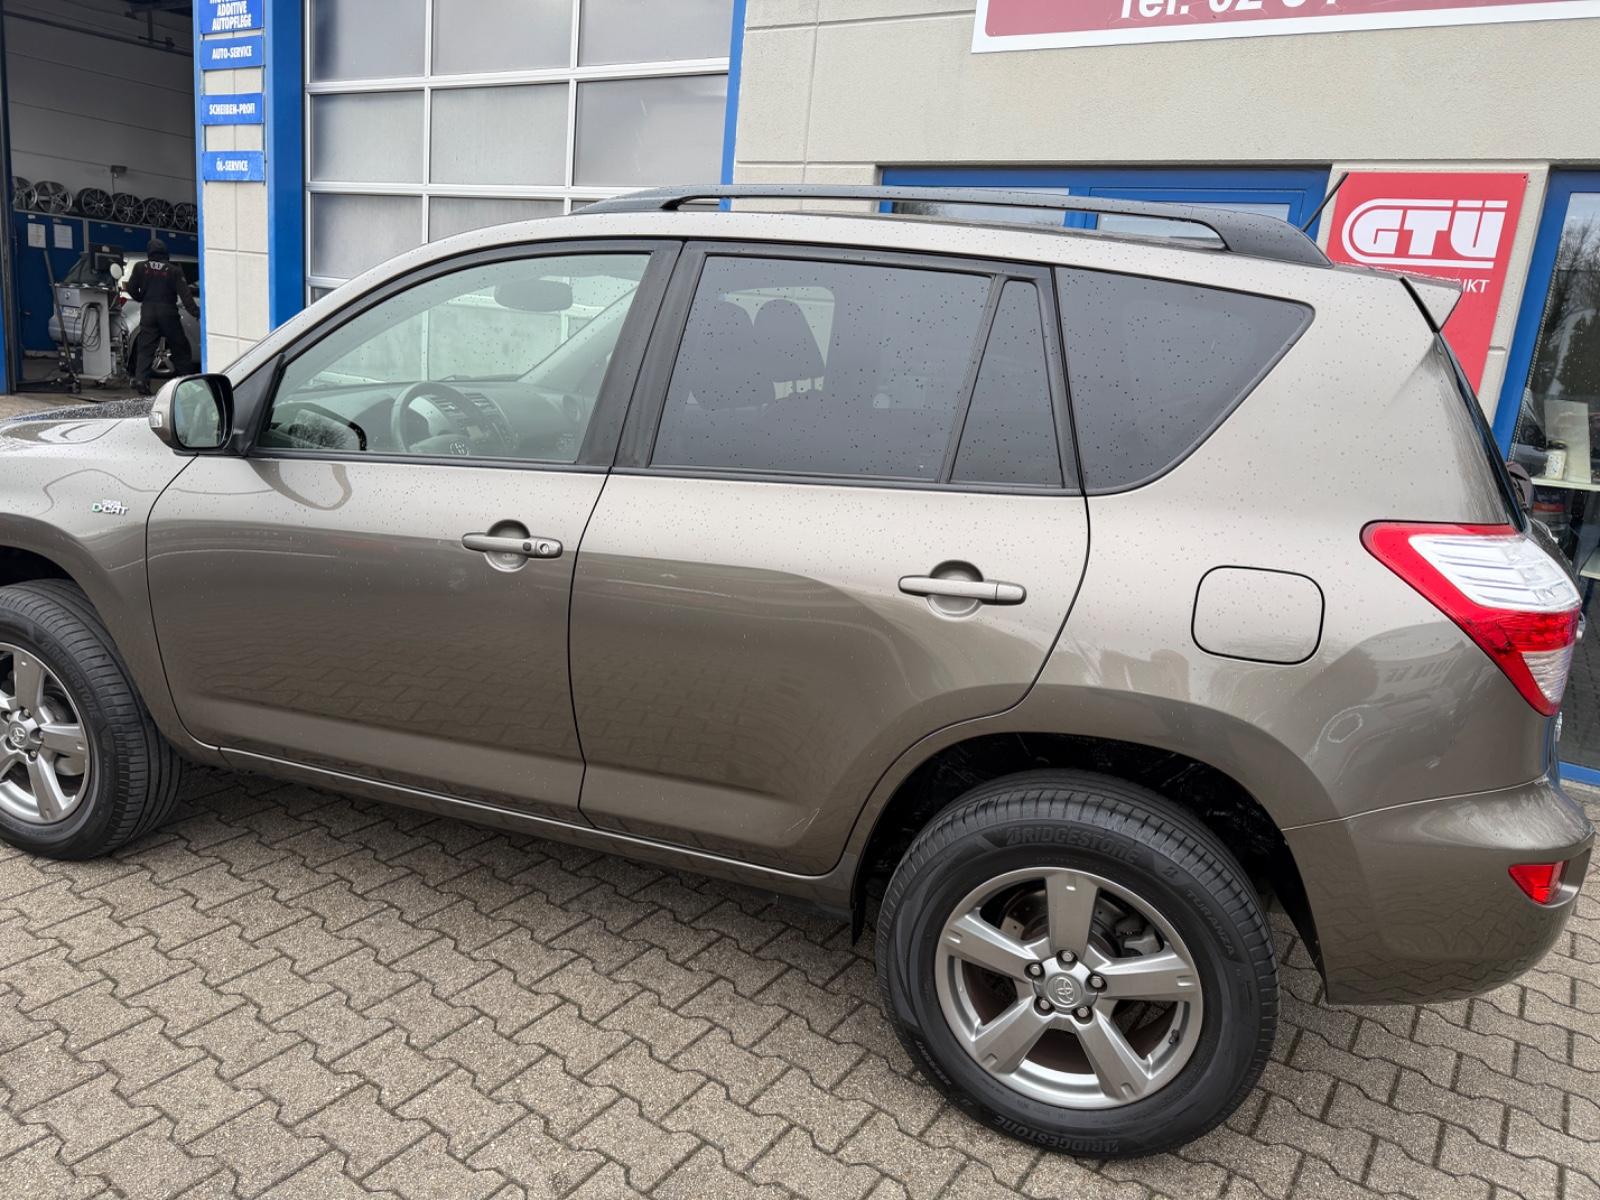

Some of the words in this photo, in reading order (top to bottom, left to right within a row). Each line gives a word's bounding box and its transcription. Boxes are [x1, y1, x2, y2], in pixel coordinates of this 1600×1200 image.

[216, 1, 247, 16] ADDITIVE
[212, 13, 251, 31] AUTOPFLEGE
[212, 45, 252, 60] AUTO-SERVICE
[209, 103, 256, 115] SCHEIBEN-PROFI
[216, 157, 248, 172] ÖL-SERVICE
[1352, 199, 1508, 258] GTÜ
[1006, 826, 1140, 864] BRIDGESTONE
[994, 1114, 1120, 1153] BRIDGESTONE
